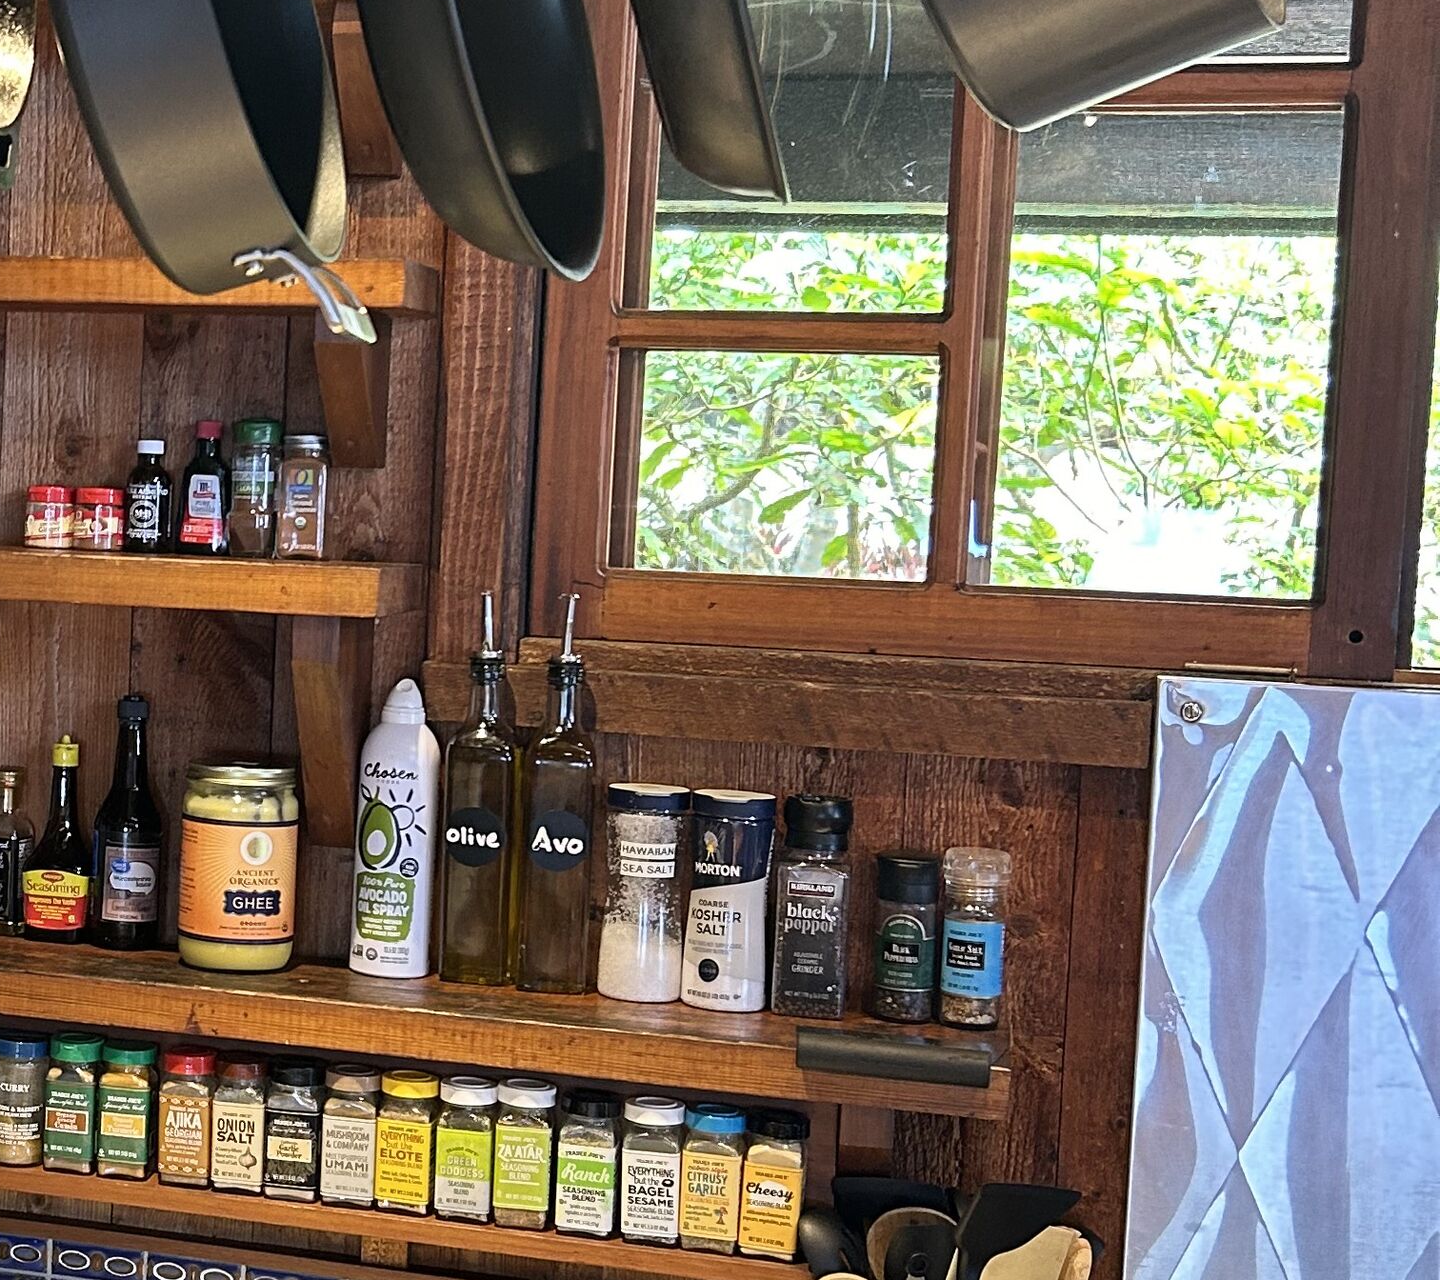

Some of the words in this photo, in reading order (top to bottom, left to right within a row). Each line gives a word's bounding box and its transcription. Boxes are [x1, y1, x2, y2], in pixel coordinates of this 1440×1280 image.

[363, 761, 419, 781] Chosen
[531, 825, 584, 855] Avo
[621, 844, 675, 857] HAWAIIAN
[236, 869, 275, 877] ANCIENT
[622, 863, 644, 874] SEA
[646, 863, 674, 875] SALT
[694, 861, 741, 878] MORTON
[26, 879, 81, 896] Seasoning
[229, 877, 280, 888] ORGANICS
[363, 875, 383, 887] 100%
[383, 877, 406, 889] Pure
[358, 886, 408, 904] AVOCADO
[232, 896, 274, 910] GHEE
[357, 900, 371, 914] OIL
[372, 903, 410, 918] SPRAY
[698, 898, 729, 908] COARSE
[691, 907, 742, 924] KOSHER
[786, 902, 833, 922] black
[696, 923, 727, 937] SALT
[791, 964, 824, 975] GRINDER
[0, 1082, 31, 1093] CURRY
[165, 1110, 202, 1130] AJIKA
[217, 1118, 255, 1134] ONION
[164, 1127, 203, 1140] GEORGIAN
[216, 1130, 255, 1145] SALT
[326, 1129, 370, 1141] MUSHROOM
[380, 1129, 425, 1144] EVERYTHING
[278, 1144, 300, 1152] Garlic
[325, 1140, 332, 1149] &
[332, 1141, 369, 1152] COMPANY
[385, 1140, 398, 1149] but
[400, 1141, 414, 1151] the
[276, 1150, 303, 1160] Powder
[379, 1147, 423, 1163] ELOTE
[497, 1144, 546, 1163] ZA'ATAR
[565, 1150, 588, 1158] TRADER
[325, 1159, 369, 1173] UMAMI
[447, 1155, 478, 1167] GREEN
[500, 1161, 540, 1174] SEASONING
[440, 1164, 485, 1179] GODDESS
[508, 1171, 531, 1181] BLEND
[560, 1161, 610, 1184] Ranch
[627, 1165, 675, 1178] EVERYTHING
[447, 1180, 475, 1190] SEASONING
[633, 1176, 647, 1185] but
[647, 1177, 660, 1186] the
[687, 1171, 729, 1186] CITRUSY
[562, 1185, 607, 1197] SEASONING
[628, 1184, 674, 1199] BAGEL
[688, 1182, 727, 1197] GARLIC
[745, 1181, 795, 1203] Cheesy
[571, 1194, 596, 1203] BLEND
[627, 1196, 674, 1208] SESAME
[746, 1198, 775, 1208] SEASONING
[626, 1205, 657, 1214] SEASONING
[657, 1207, 675, 1216] BLEND
